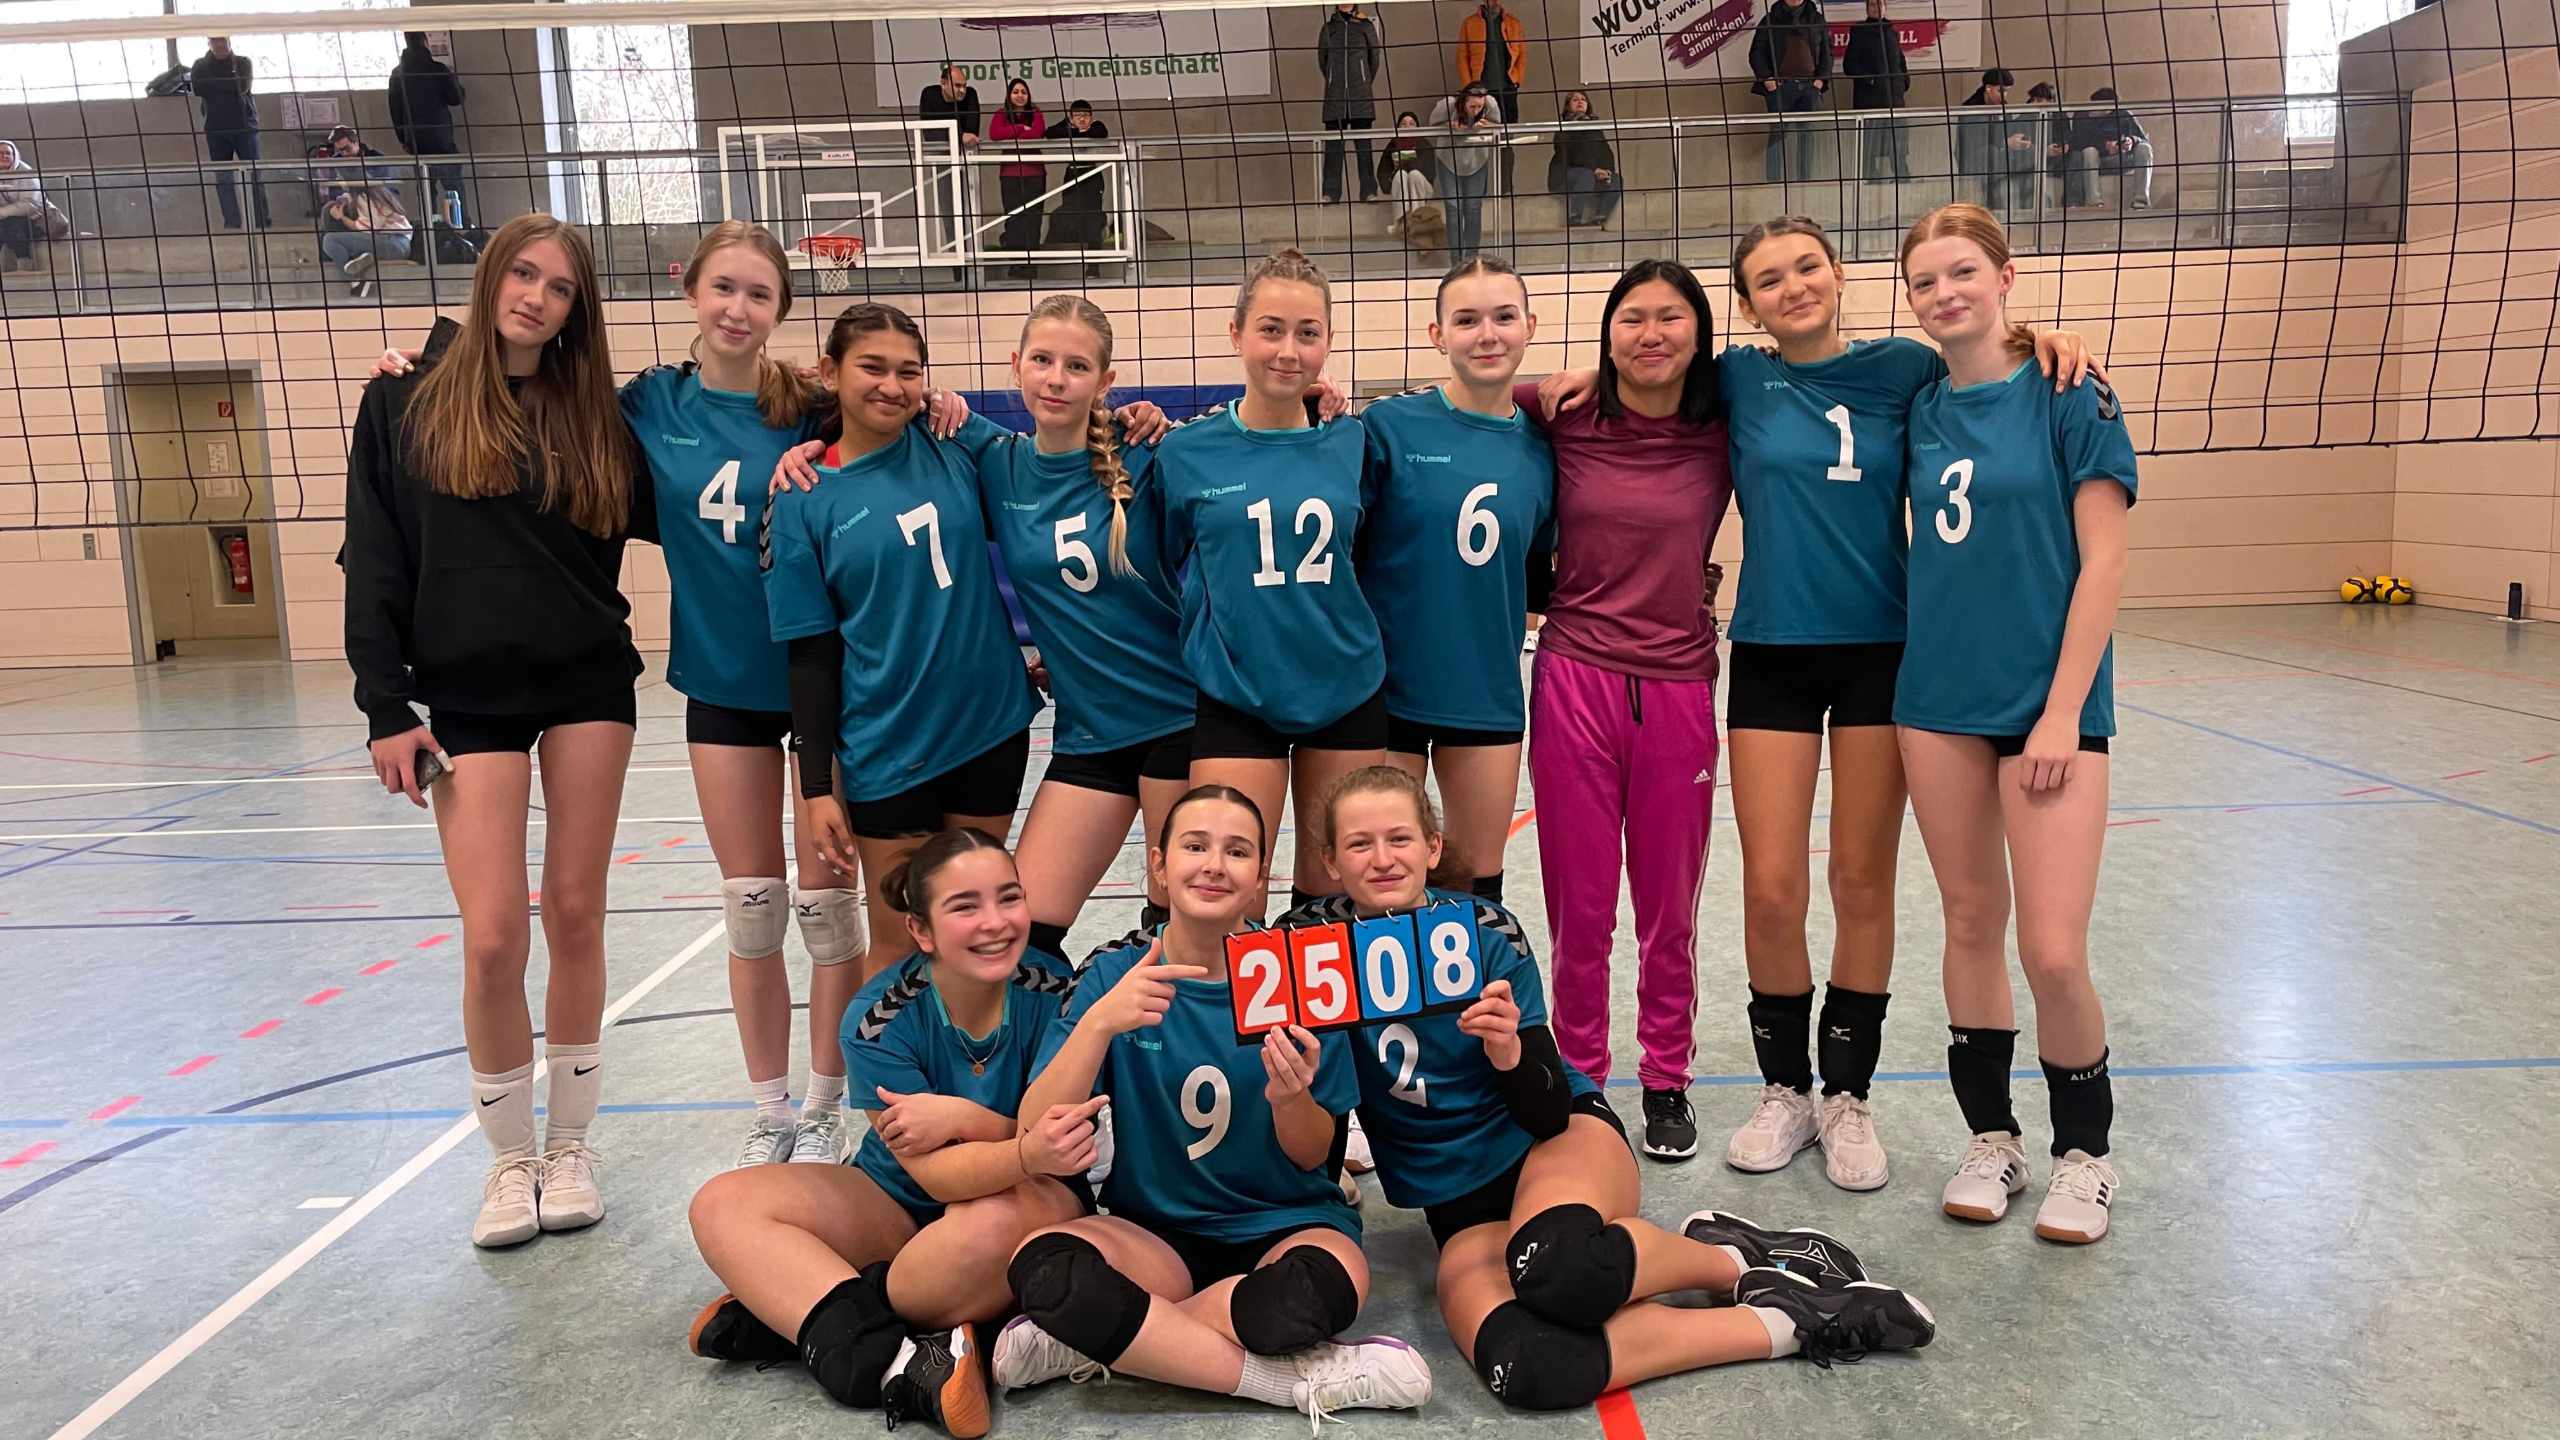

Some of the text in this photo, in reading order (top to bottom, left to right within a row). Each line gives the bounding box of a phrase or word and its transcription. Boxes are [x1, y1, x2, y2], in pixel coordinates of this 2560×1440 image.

[1019, 60, 1032, 79] &
[1041, 53, 1220, 78] Gemeinschaft
[1825, 404, 1862, 482] 1
[698, 460, 746, 544] 4
[1247, 498, 1334, 587] 12
[1456, 482, 1500, 566] 6
[1935, 458, 1974, 544] 3
[896, 502, 952, 589] 7
[1054, 511, 1099, 593] 5
[1378, 1023, 1427, 1108] 2
[1180, 1065, 1231, 1161] 9
